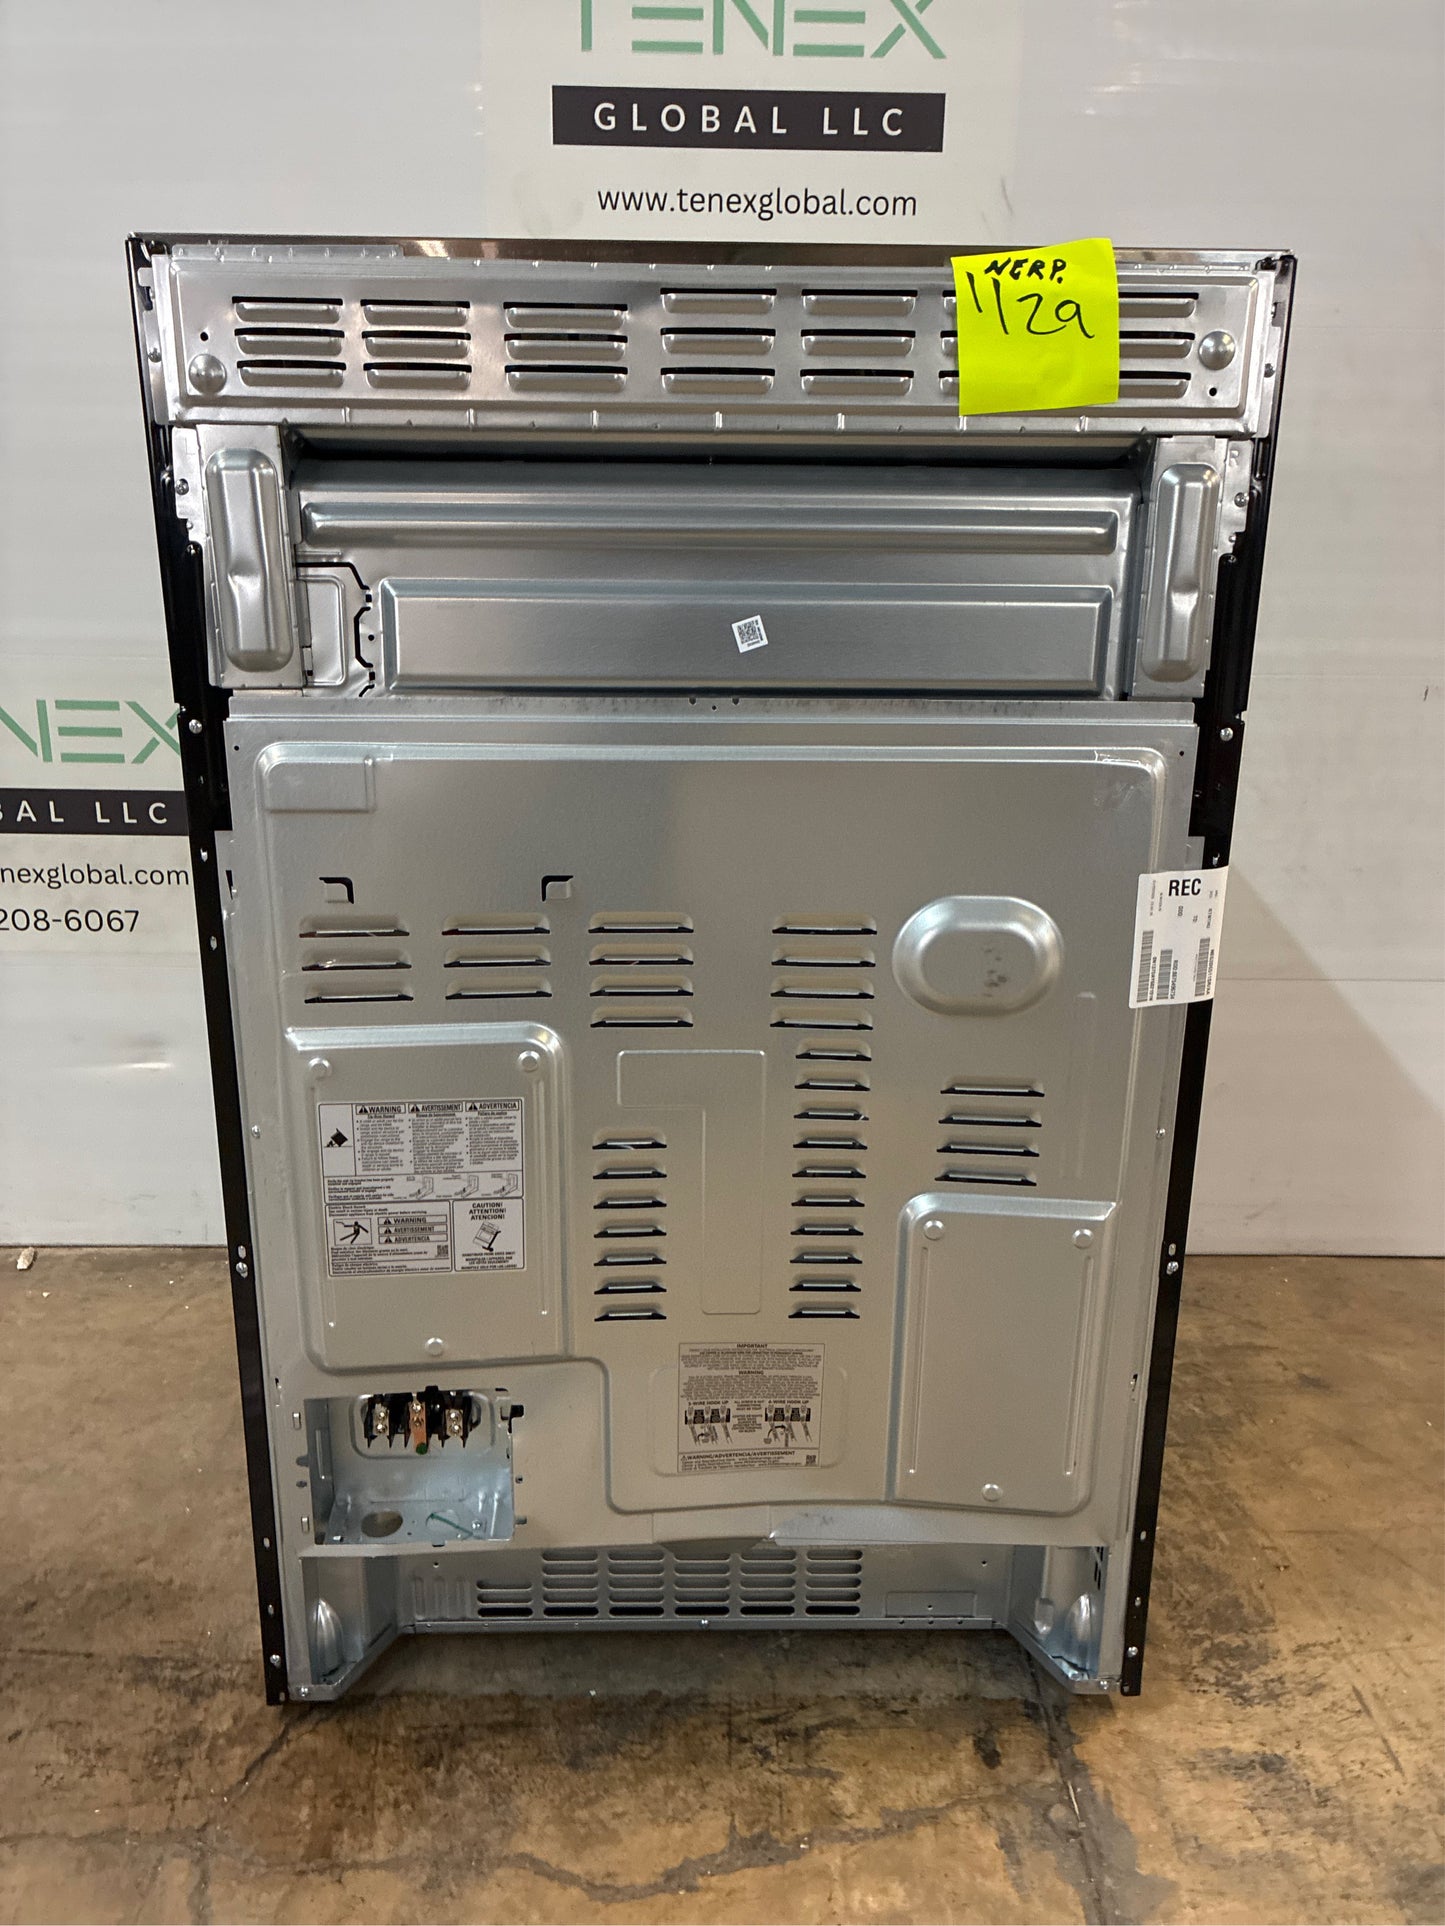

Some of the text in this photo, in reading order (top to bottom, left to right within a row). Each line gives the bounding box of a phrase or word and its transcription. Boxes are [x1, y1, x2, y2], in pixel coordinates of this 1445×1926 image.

[593, 102, 904, 137] GLOBAL LLC
[597, 187, 918, 222] www.tenexglobal.com
[0, 800, 168, 825] AL LLC
[1168, 877, 1202, 897] REC
[368, 1105, 402, 1114] WARNING
[421, 1103, 461, 1112] AVERTISSEMENT
[479, 1101, 517, 1110] ADVERTENCIA
[393, 1217, 427, 1225] WARNING
[394, 1226, 435, 1234] AVERTISSEMENT
[394, 1235, 431, 1243] ADVERTENCIA
